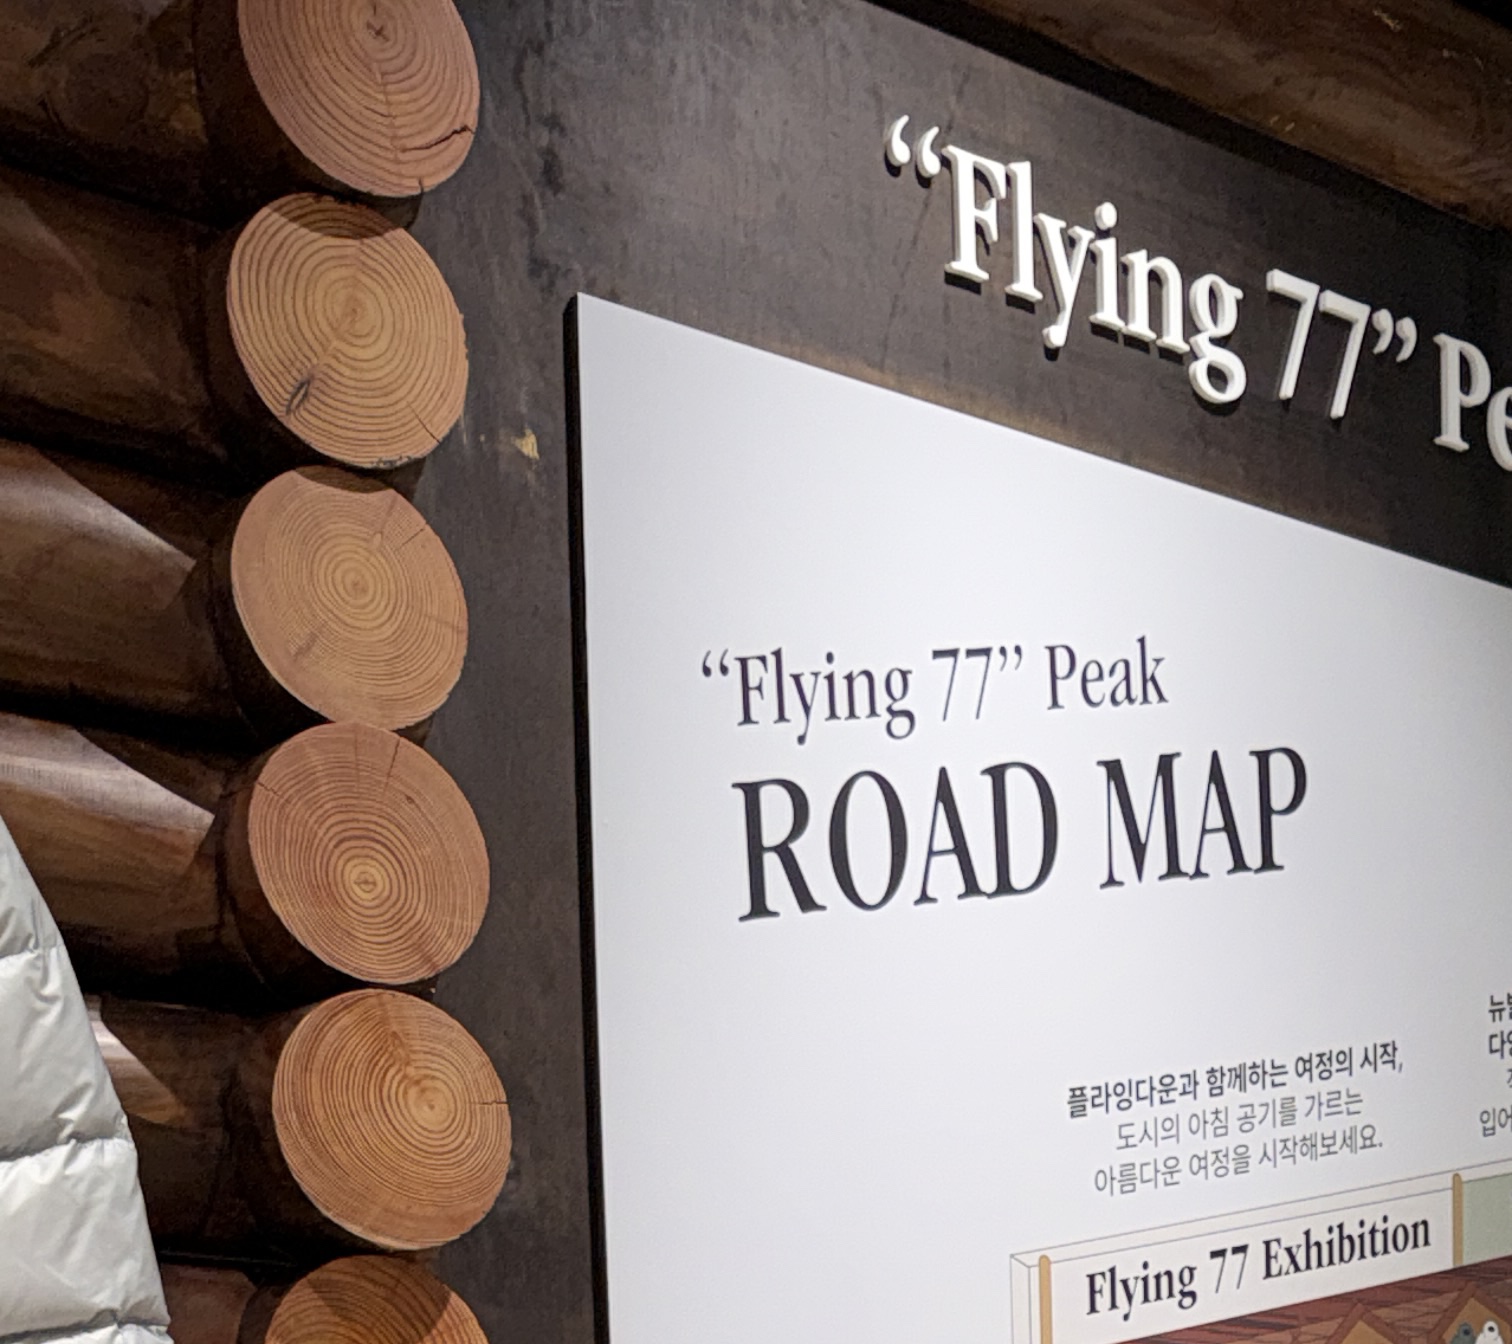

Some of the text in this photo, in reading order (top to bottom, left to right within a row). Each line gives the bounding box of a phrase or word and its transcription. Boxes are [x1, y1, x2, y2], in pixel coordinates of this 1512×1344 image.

[1045, 635, 1169, 710] Peak
[731, 746, 1307, 922] ROAD MAP
[1067, 1040, 1404, 1119] 플라잉다운과 함께하는 여정의 시작,
[1116, 1088, 1364, 1151] 도시의 아침 공기를 가르는
[1094, 1124, 1384, 1197] 아름다운 여정을 시작해보세요.
[1086, 1215, 1431, 1321] Flying 77 Exhibition
